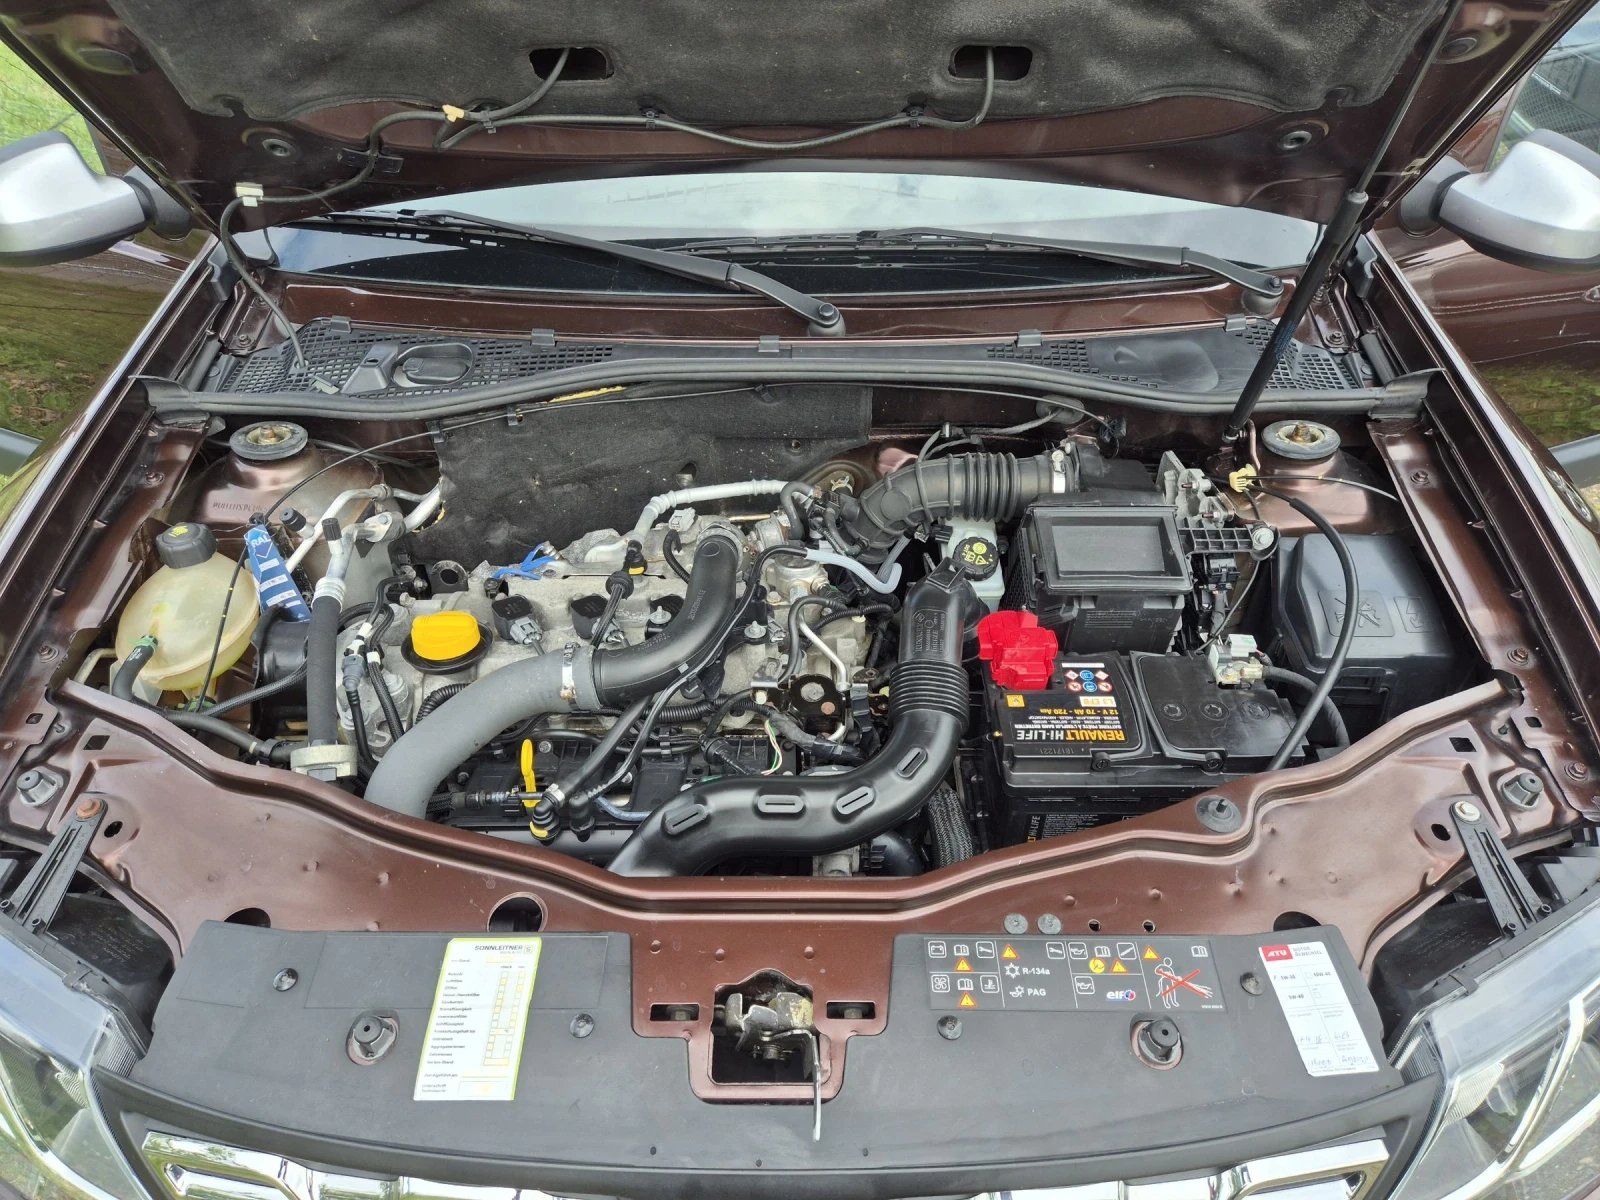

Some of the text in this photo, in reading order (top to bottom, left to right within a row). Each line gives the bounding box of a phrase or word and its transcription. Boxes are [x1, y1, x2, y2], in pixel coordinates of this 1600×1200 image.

[250, 534, 271, 548] RAL
[1066, 730, 1125, 741] RENAULT
[1022, 966, 1050, 976] R-134a
[1027, 988, 1046, 996] PAG
[1106, 990, 1126, 1000] elf
